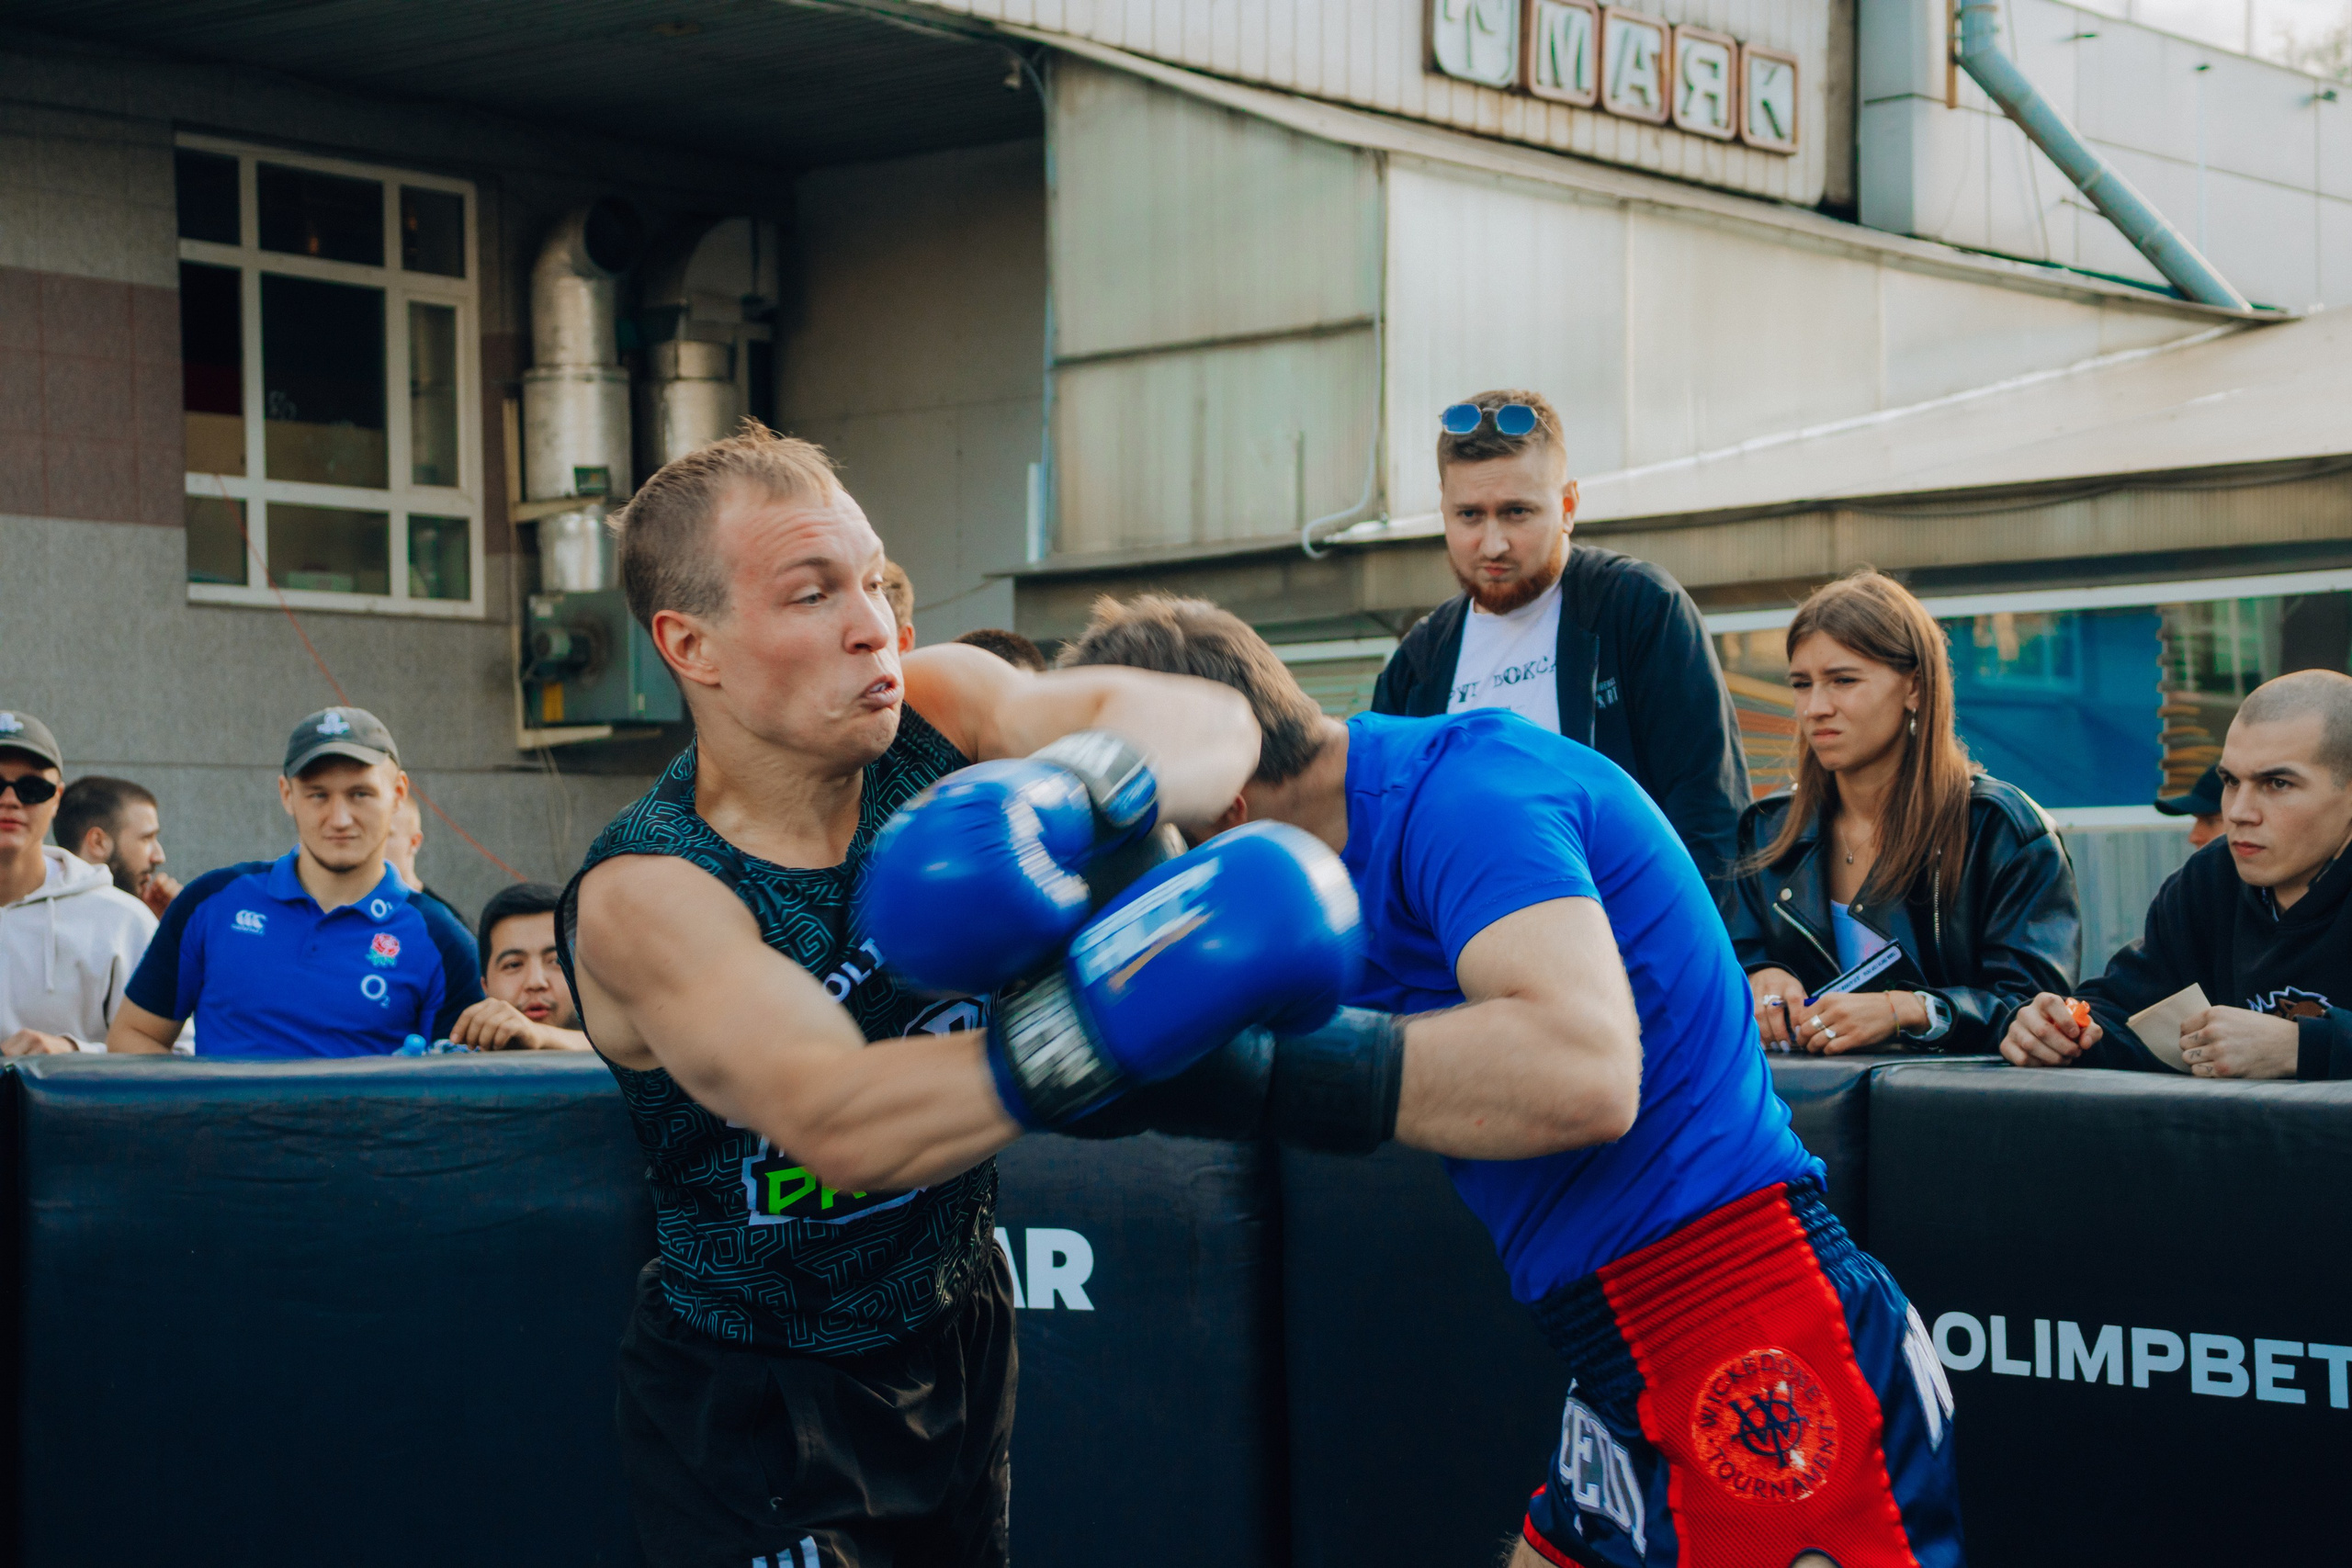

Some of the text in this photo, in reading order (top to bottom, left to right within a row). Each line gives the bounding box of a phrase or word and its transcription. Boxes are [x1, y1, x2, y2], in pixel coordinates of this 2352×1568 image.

[1535, 3, 1793, 141] МАЯК
[1932, 1311, 2352, 1410] OLIMPBET
[1708, 1421, 1836, 1500] TOURNAMENT
